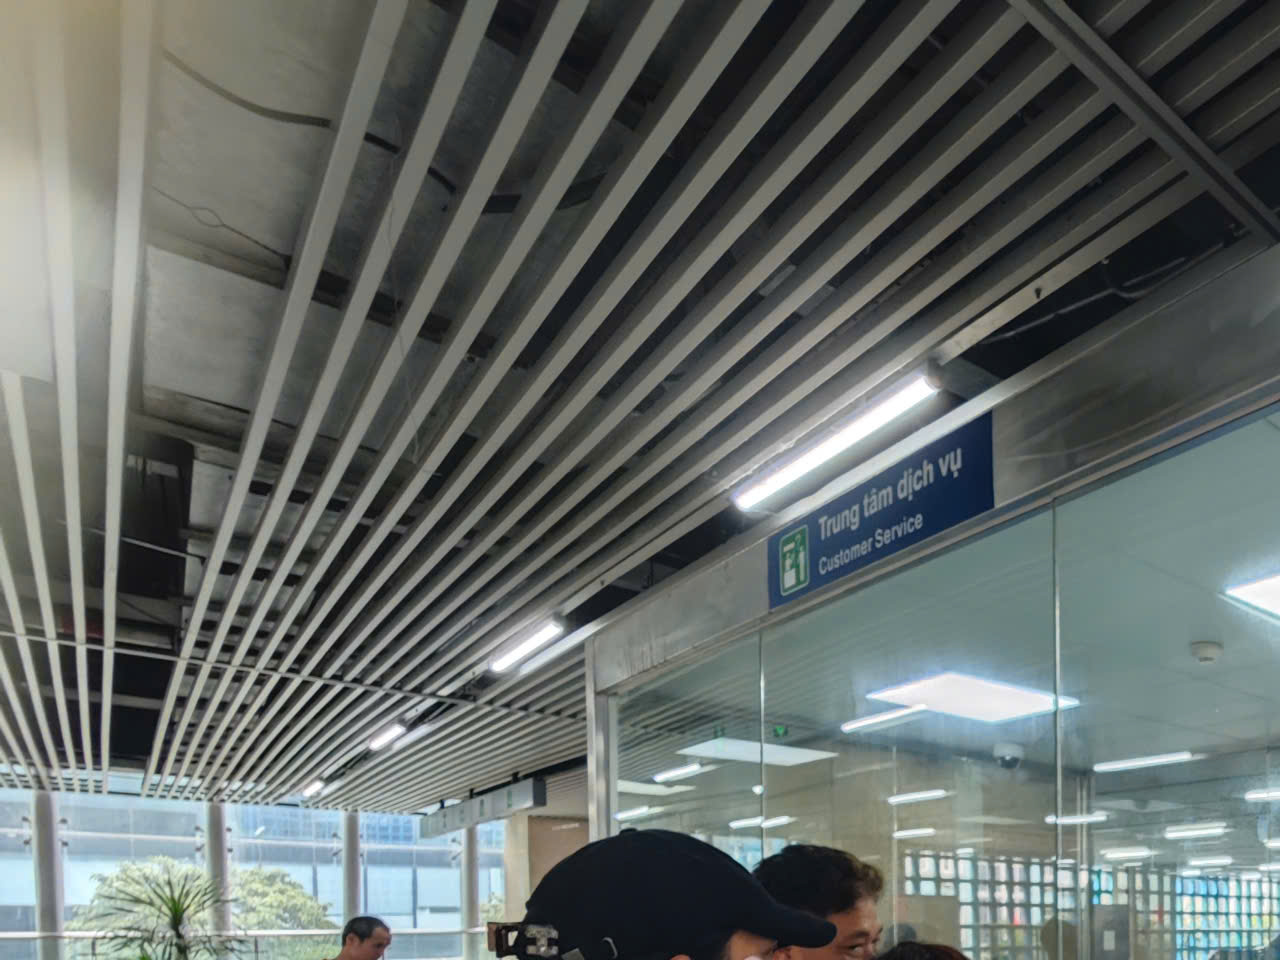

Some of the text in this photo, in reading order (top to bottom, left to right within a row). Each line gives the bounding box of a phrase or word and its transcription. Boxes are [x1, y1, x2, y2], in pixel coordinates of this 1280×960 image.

[818, 448, 963, 541] Trung tâm dịch vụ
[818, 512, 923, 576] Customer Service
